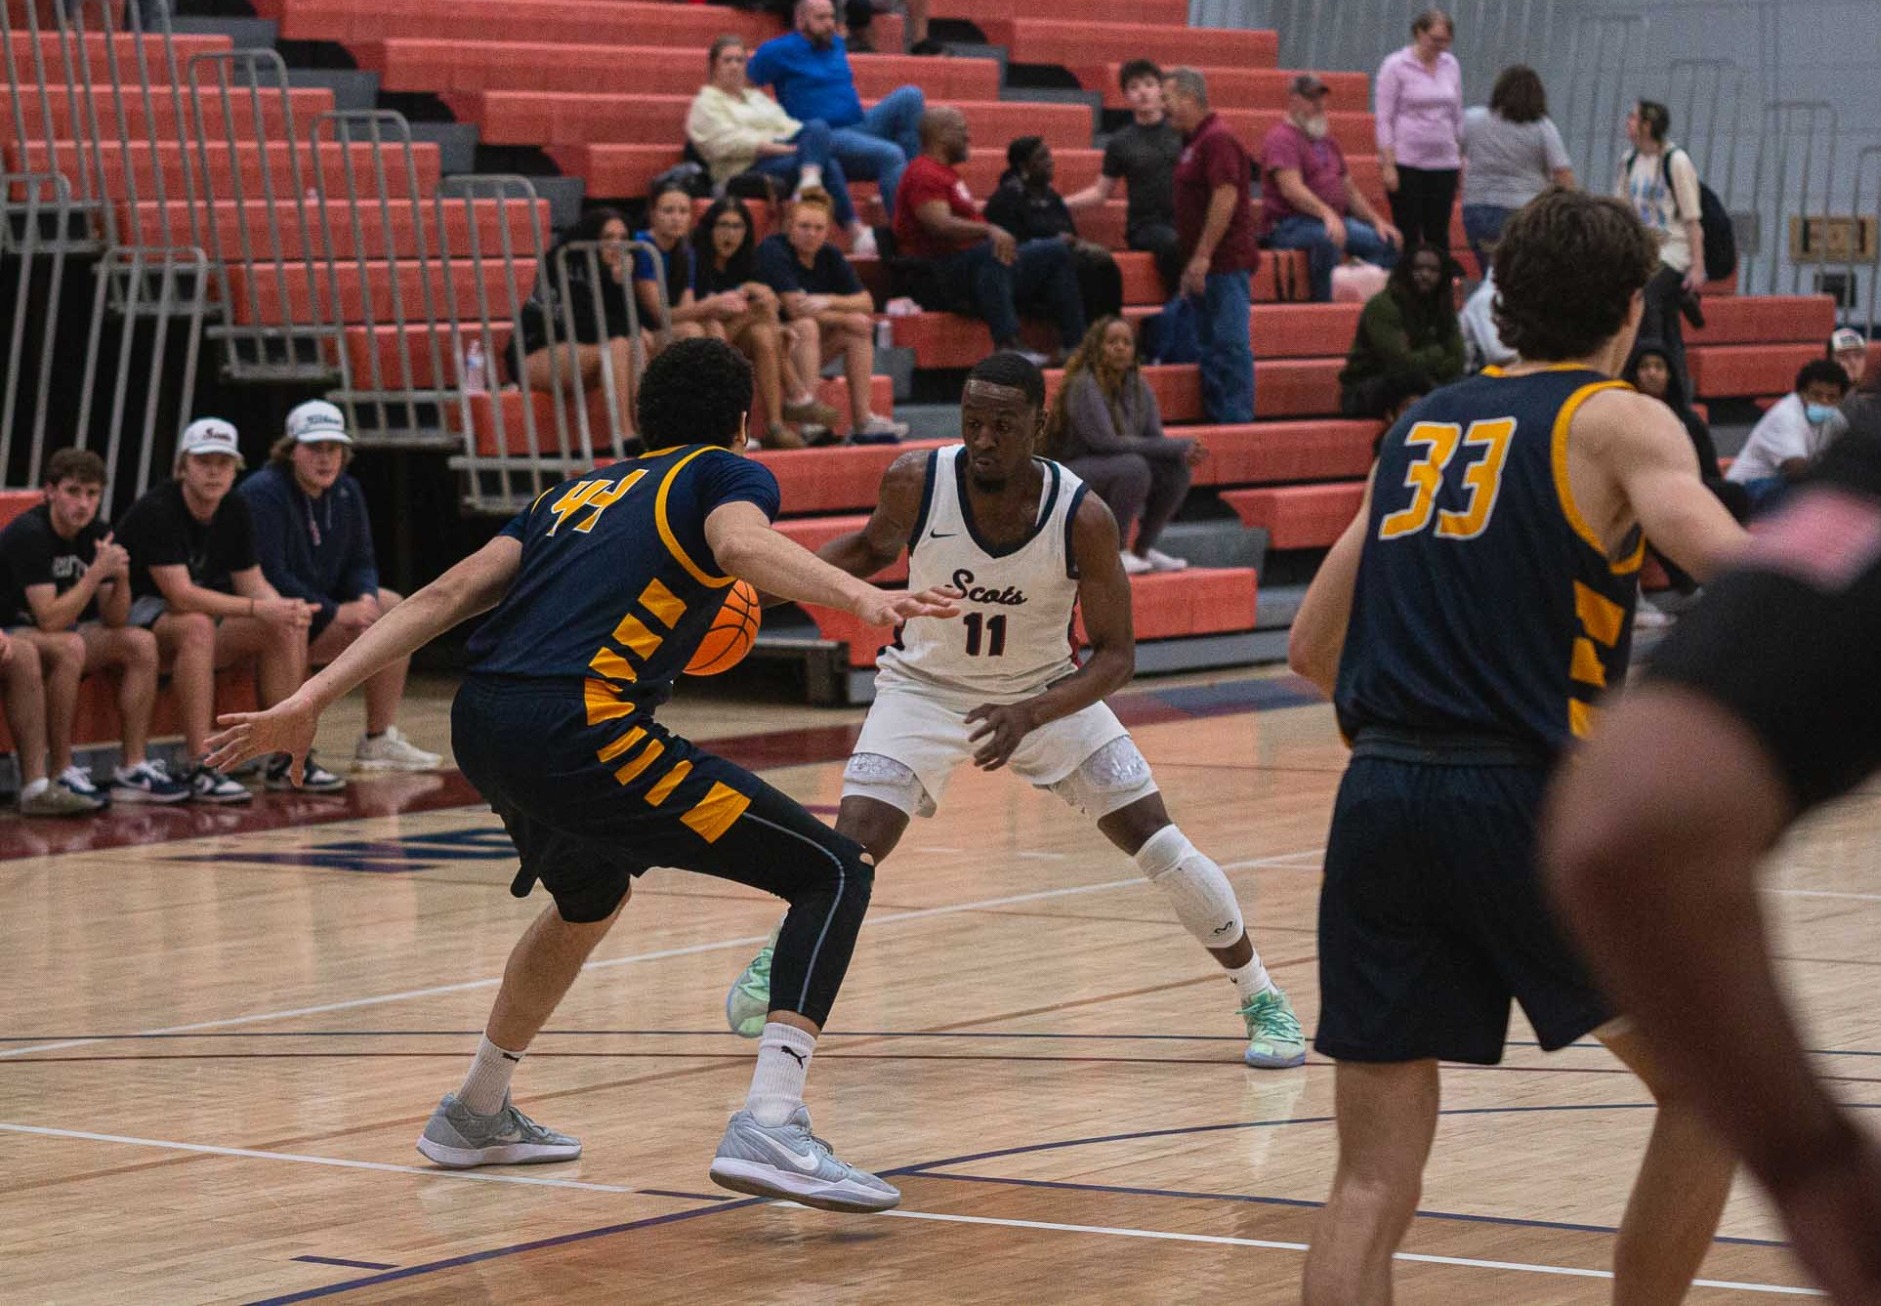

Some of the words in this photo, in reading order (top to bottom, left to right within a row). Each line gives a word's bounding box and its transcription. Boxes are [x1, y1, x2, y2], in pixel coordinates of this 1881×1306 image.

[546, 468, 650, 537] 44
[1379, 416, 1517, 541] 33
[944, 568, 1028, 606] Scots
[963, 612, 1007, 657] 11
